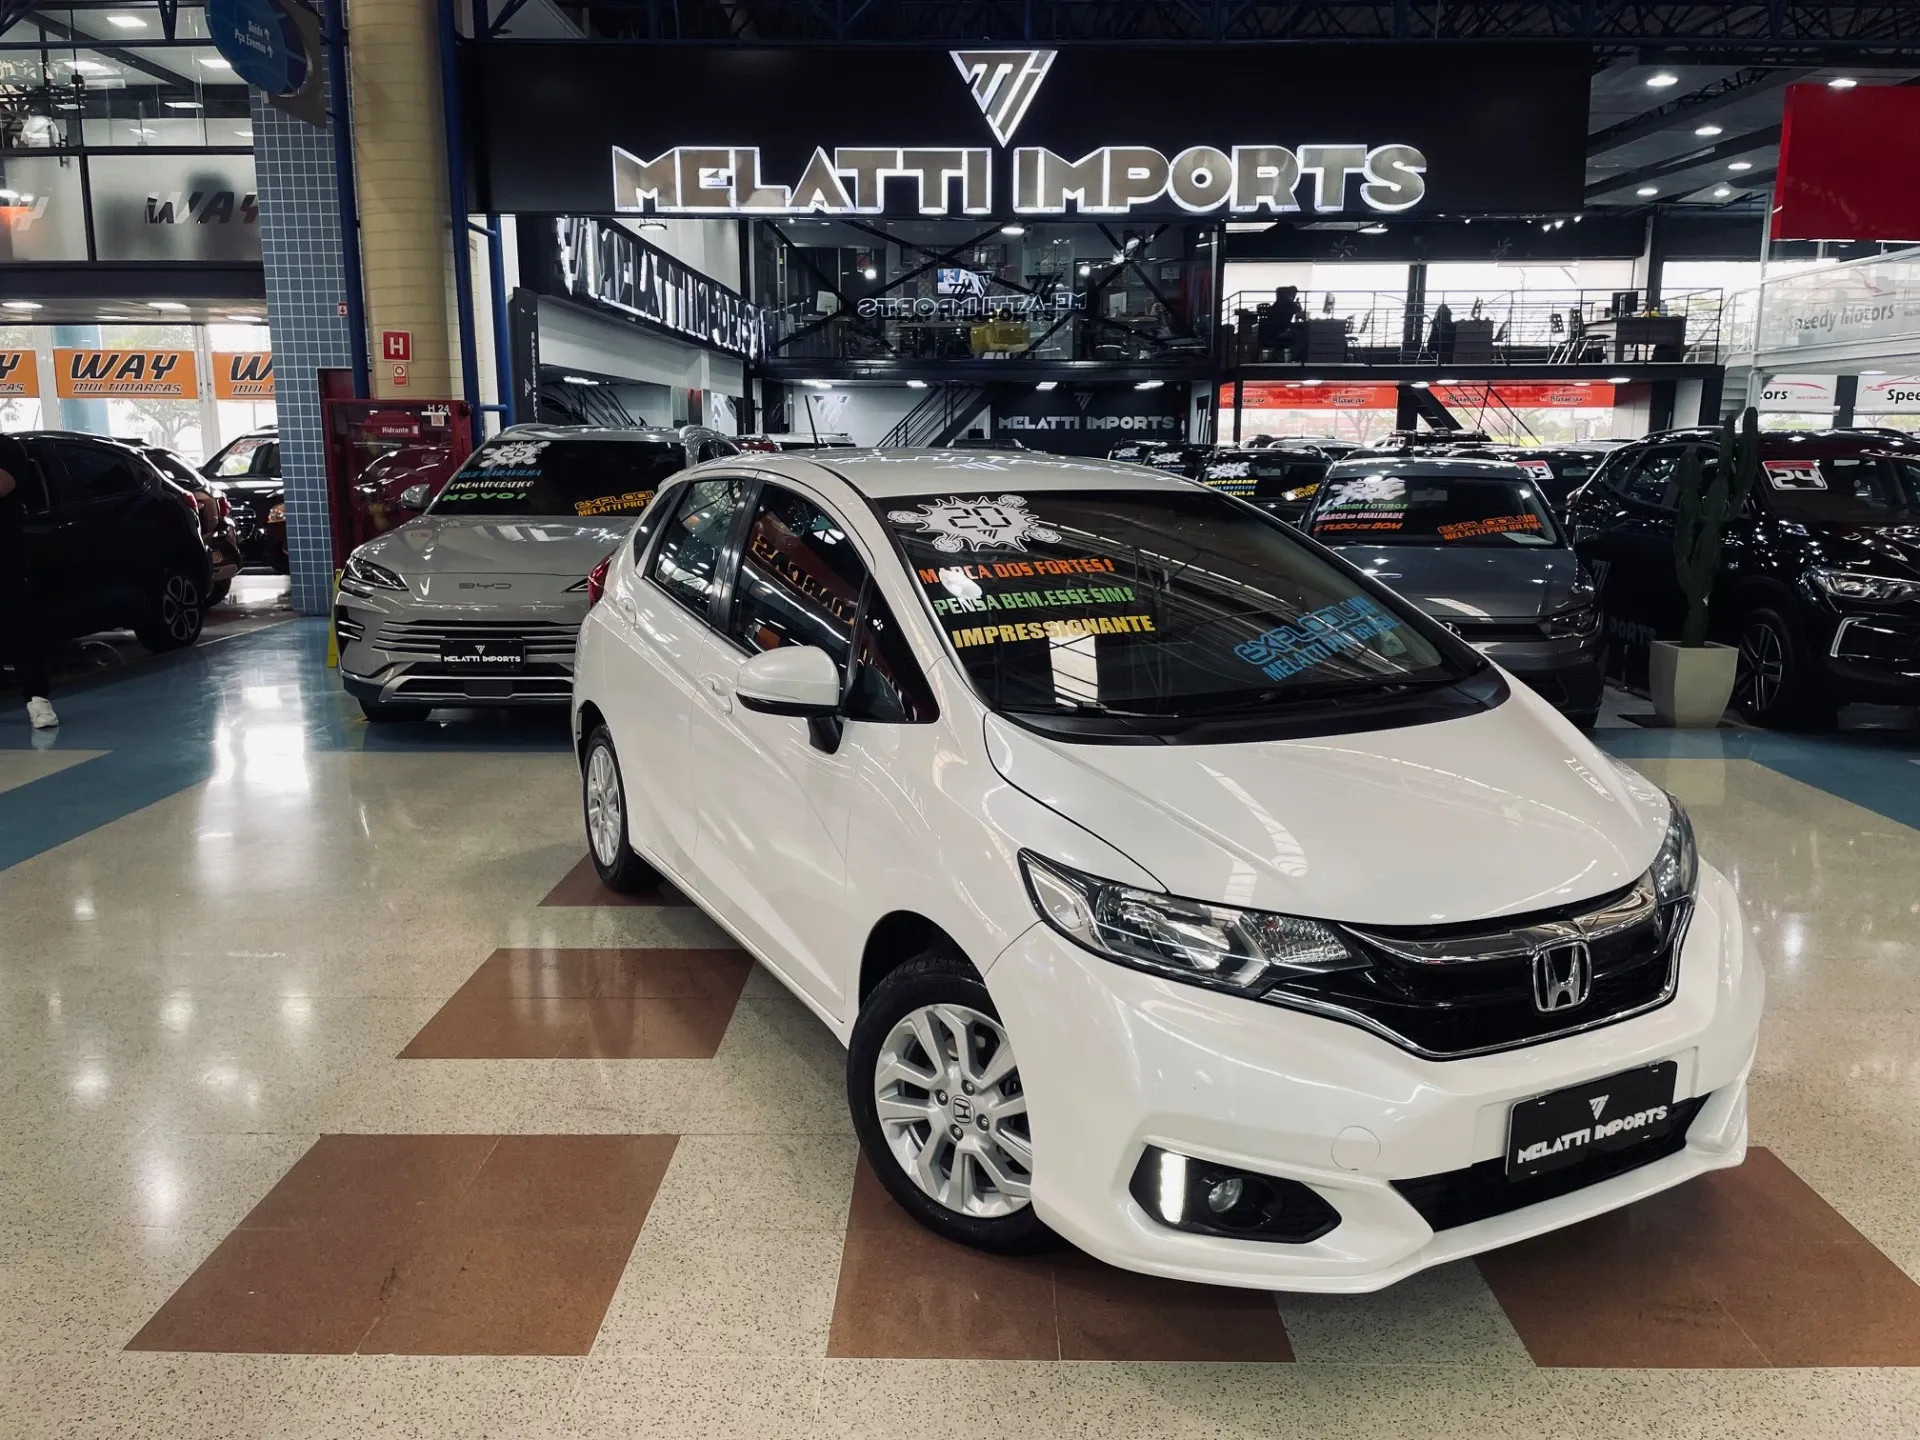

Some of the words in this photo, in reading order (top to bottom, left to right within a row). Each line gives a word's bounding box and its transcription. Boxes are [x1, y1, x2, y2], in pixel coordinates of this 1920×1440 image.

[612, 145, 992, 214] MELATTI
[1013, 143, 1427, 214] IMPORTS
[389, 337, 404, 355] H
[71, 353, 179, 380] WAY
[998, 416, 1080, 430] MELATTI
[1086, 416, 1176, 430] IMPORTS
[1773, 469, 1825, 489] 24
[578, 503, 622, 516] MELATTI
[624, 500, 644, 508] PRO
[943, 507, 1012, 528] 20
[1316, 512, 1347, 521] MARCA
[1443, 528, 1486, 540] MELATTI
[918, 565, 994, 584] MRCA
[992, 563, 1033, 578] DOS
[1036, 558, 1115, 576] FORTES!
[458, 582, 512, 590] BYD
[933, 595, 1002, 616] PENSA
[952, 615, 1155, 648] IMPRESSIONANTE
[1261, 642, 1328, 682] MELATTI
[1516, 1127, 1590, 1164] MELATTI
[1594, 1105, 1668, 1141] IMPORTS
